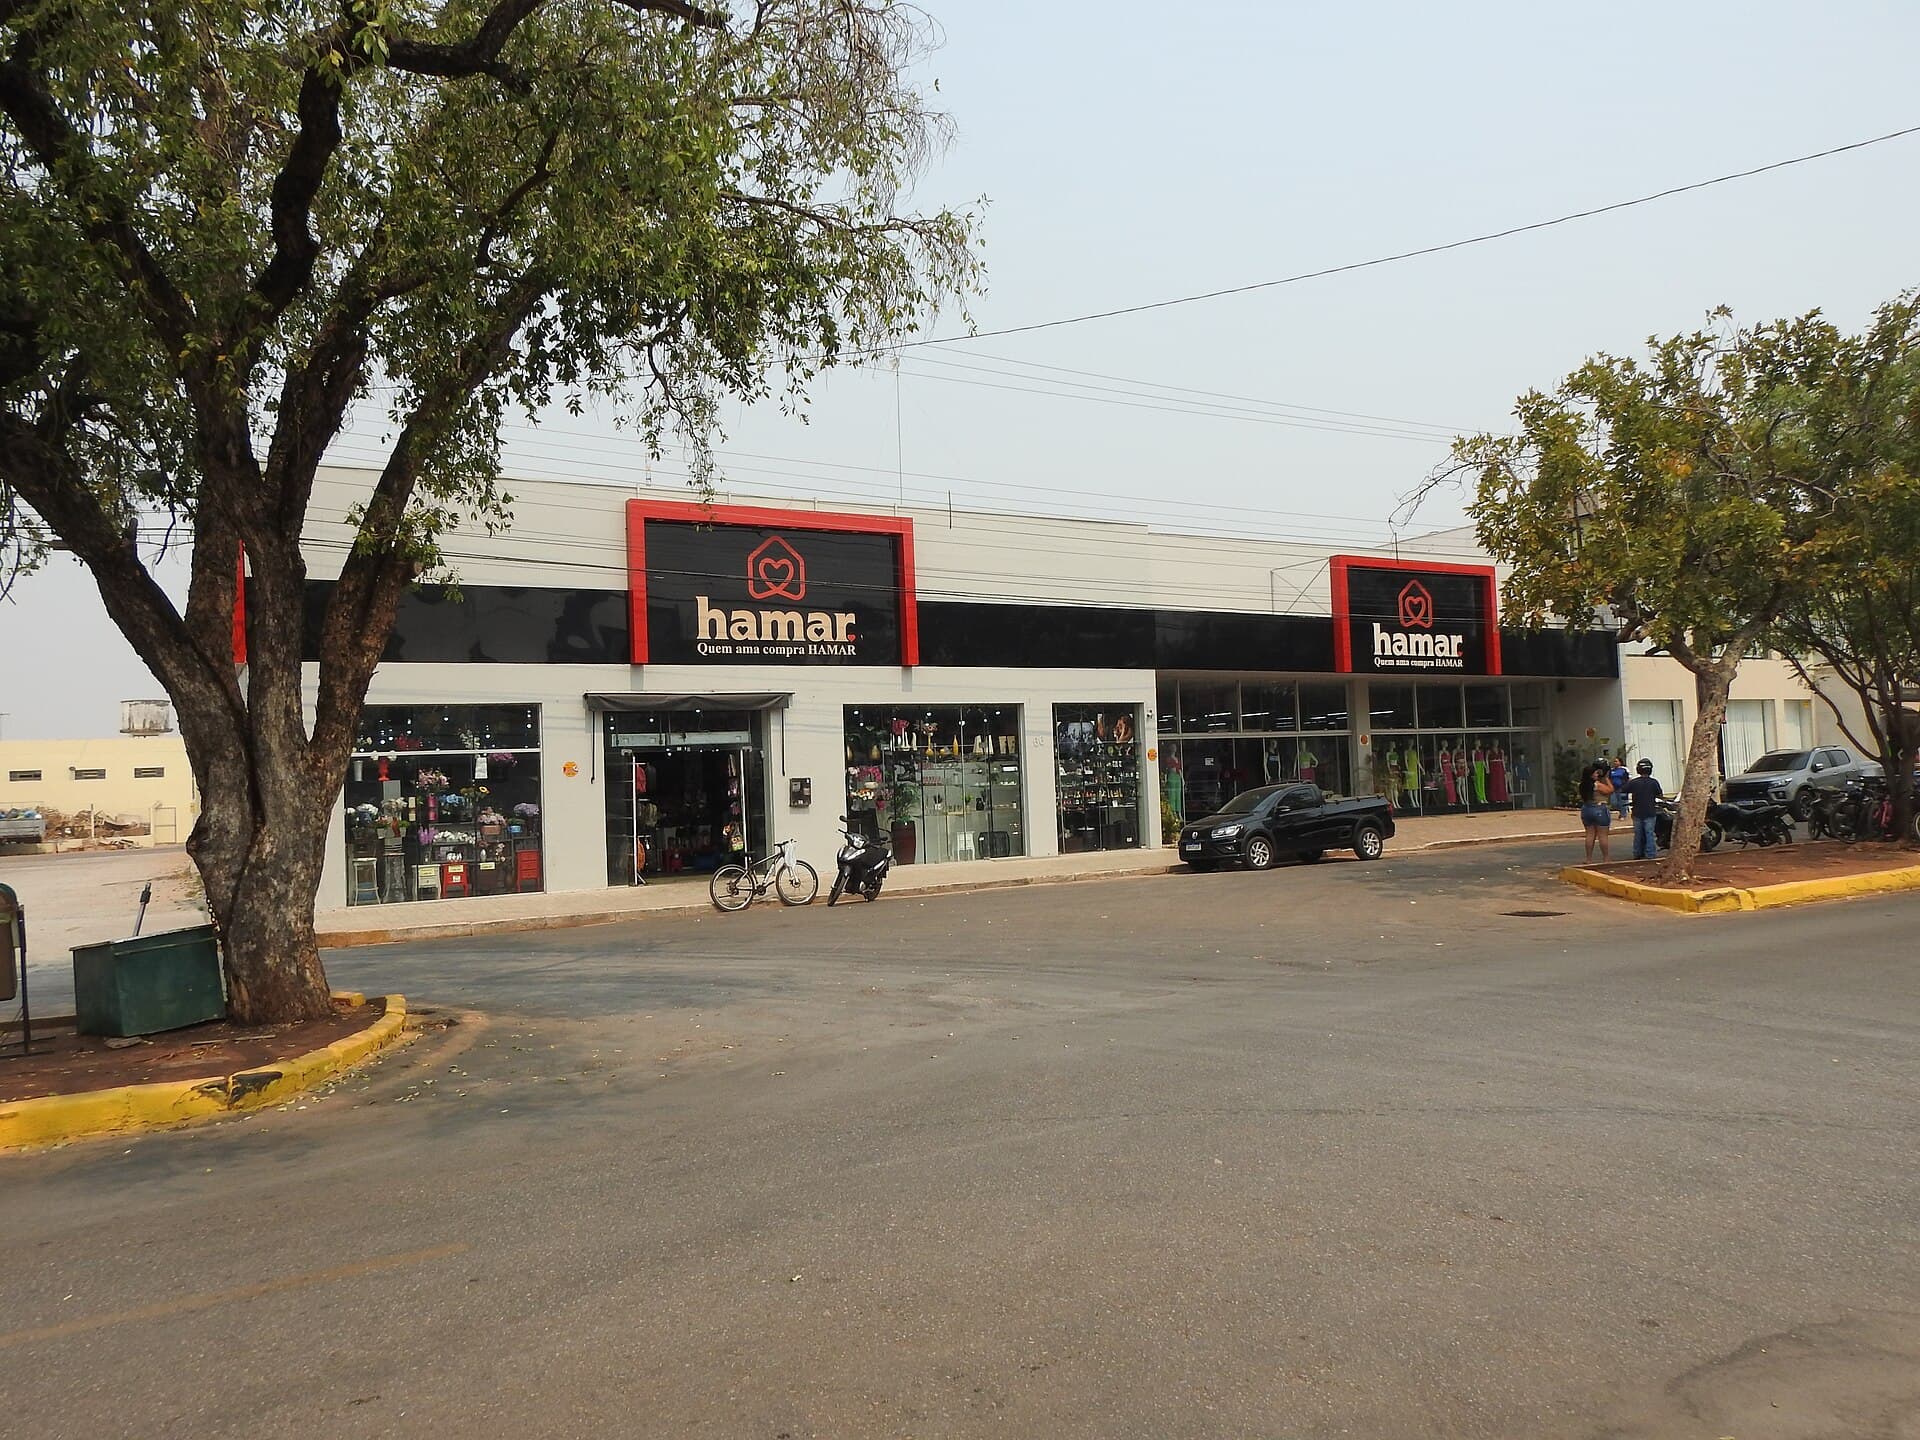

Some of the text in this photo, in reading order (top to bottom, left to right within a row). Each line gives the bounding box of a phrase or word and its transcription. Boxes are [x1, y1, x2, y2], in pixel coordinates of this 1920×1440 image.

[696, 596, 856, 642] hamar
[697, 642, 857, 658] Quem ama compra HAMAR
[1373, 622, 1463, 657] hamar
[1436, 659, 1463, 668] HAMAR
